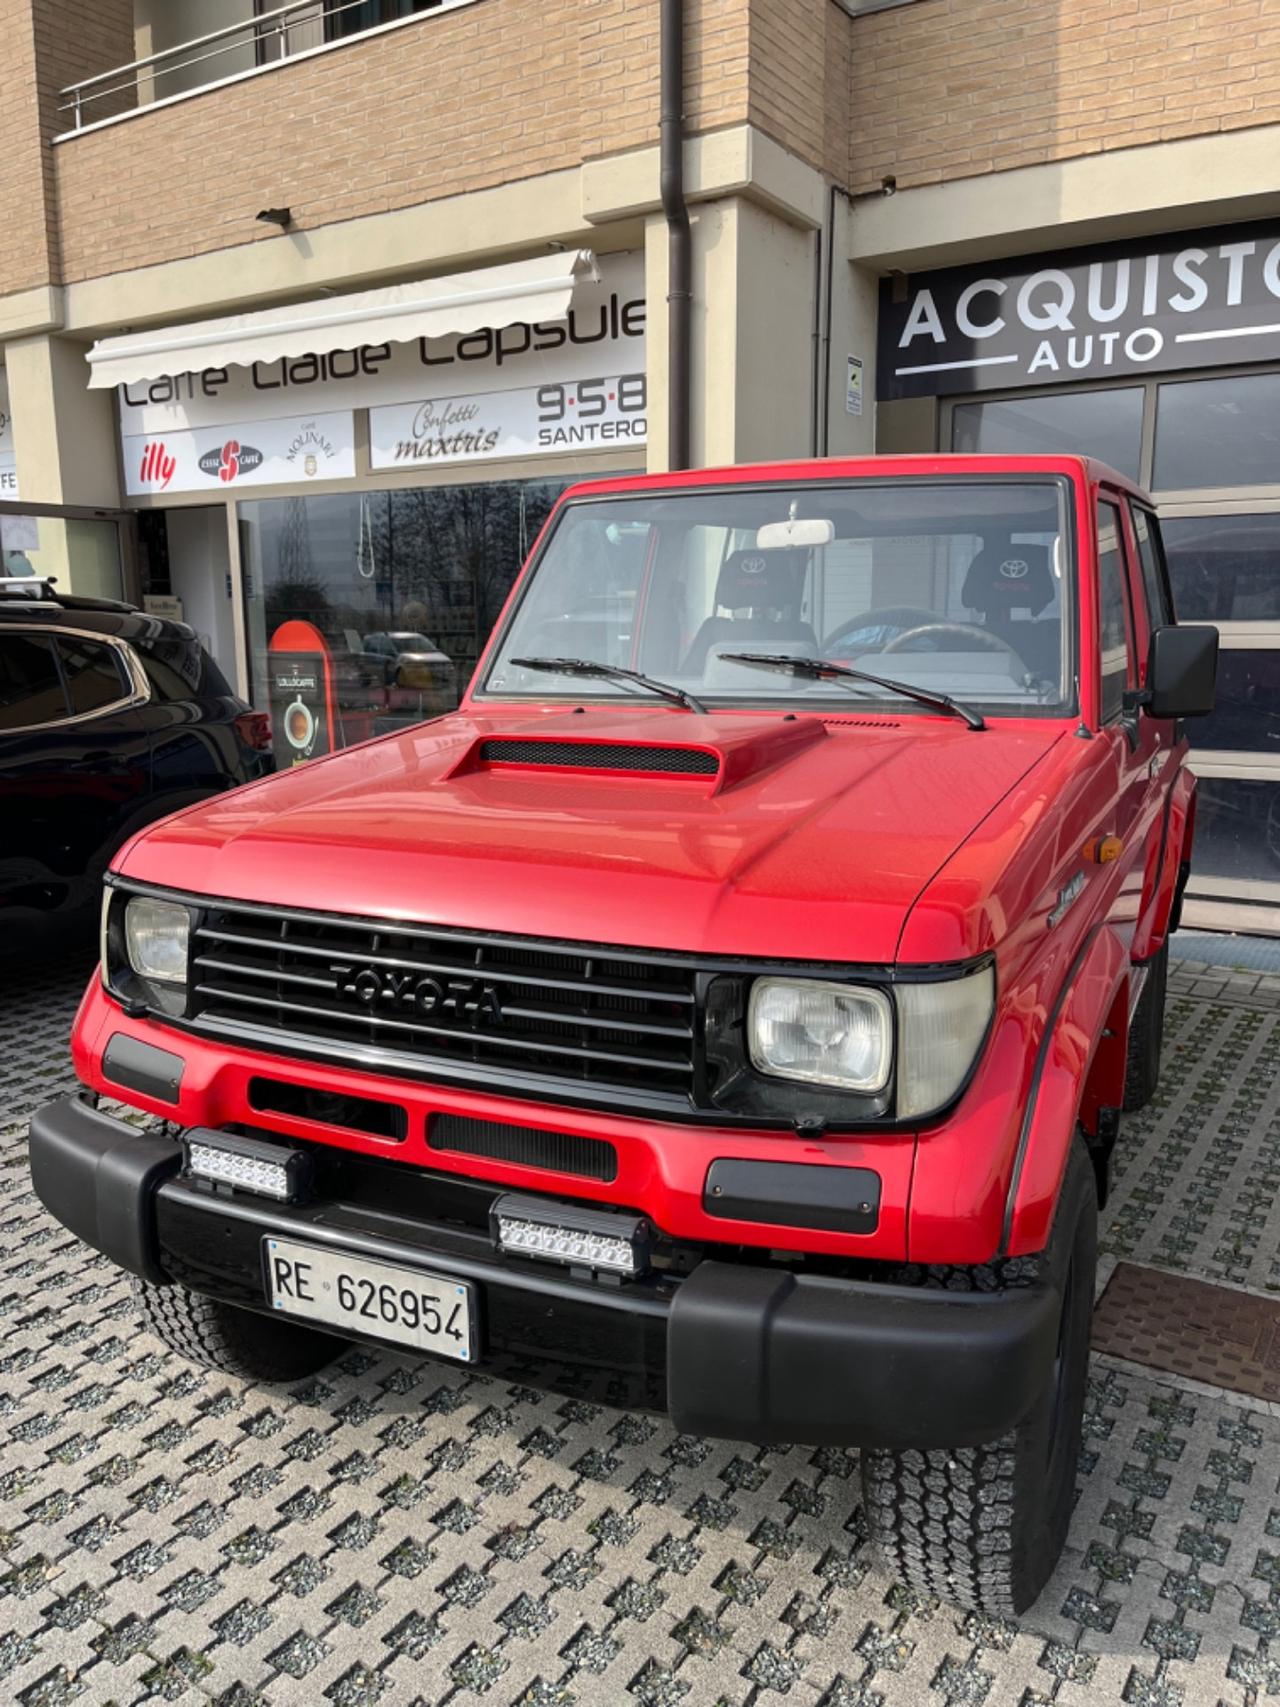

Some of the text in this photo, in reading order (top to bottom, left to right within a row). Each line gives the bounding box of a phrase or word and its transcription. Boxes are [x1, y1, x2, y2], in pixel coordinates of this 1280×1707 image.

[1028, 327, 1165, 373] AUTO
[413, 400, 480, 439] Confetti
[539, 418, 647, 446] SANTERO
[140, 441, 176, 489] illy
[286, 431, 338, 464] MOLINARI
[395, 428, 498, 460] maxtris
[329, 965, 504, 1024] TOYOTA
[273, 1257, 464, 1341] RE 626954
